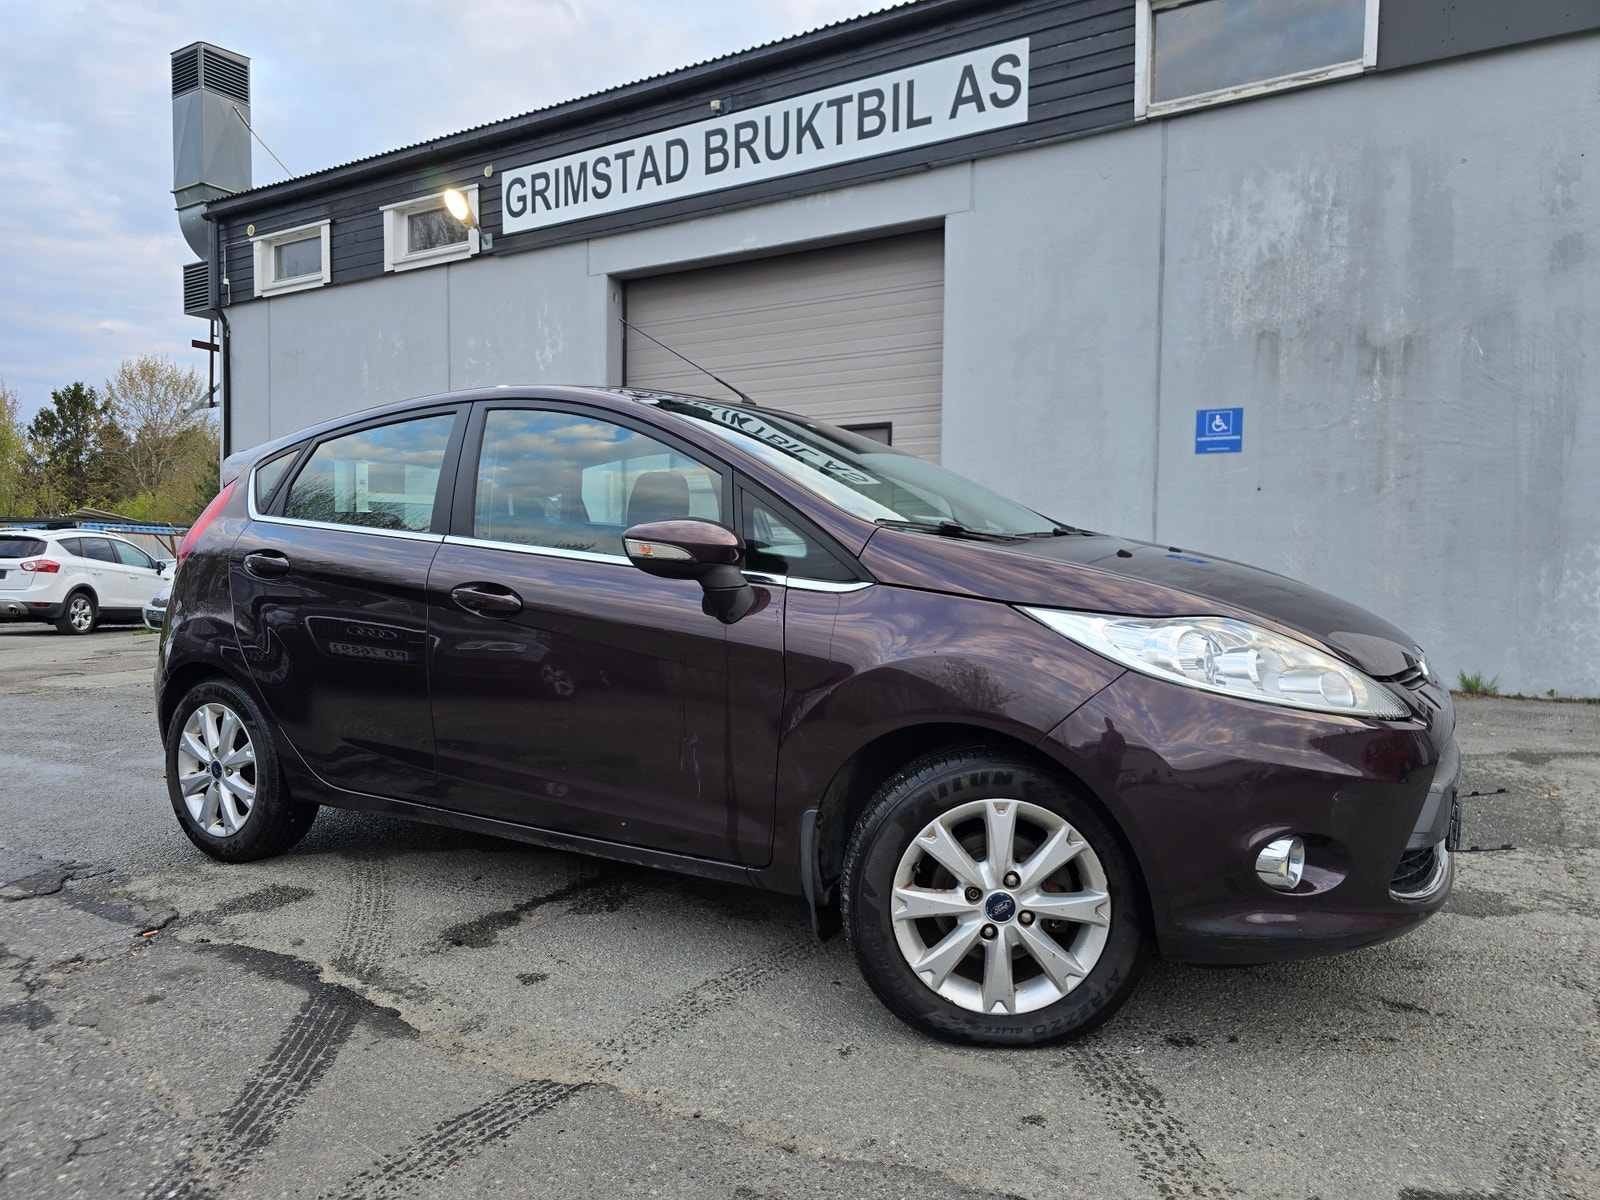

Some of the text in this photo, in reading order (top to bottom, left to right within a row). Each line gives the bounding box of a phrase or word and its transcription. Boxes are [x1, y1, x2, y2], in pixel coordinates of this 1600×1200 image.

[506, 53, 1022, 218] GRIMSTAD BRUKTBIL AS
